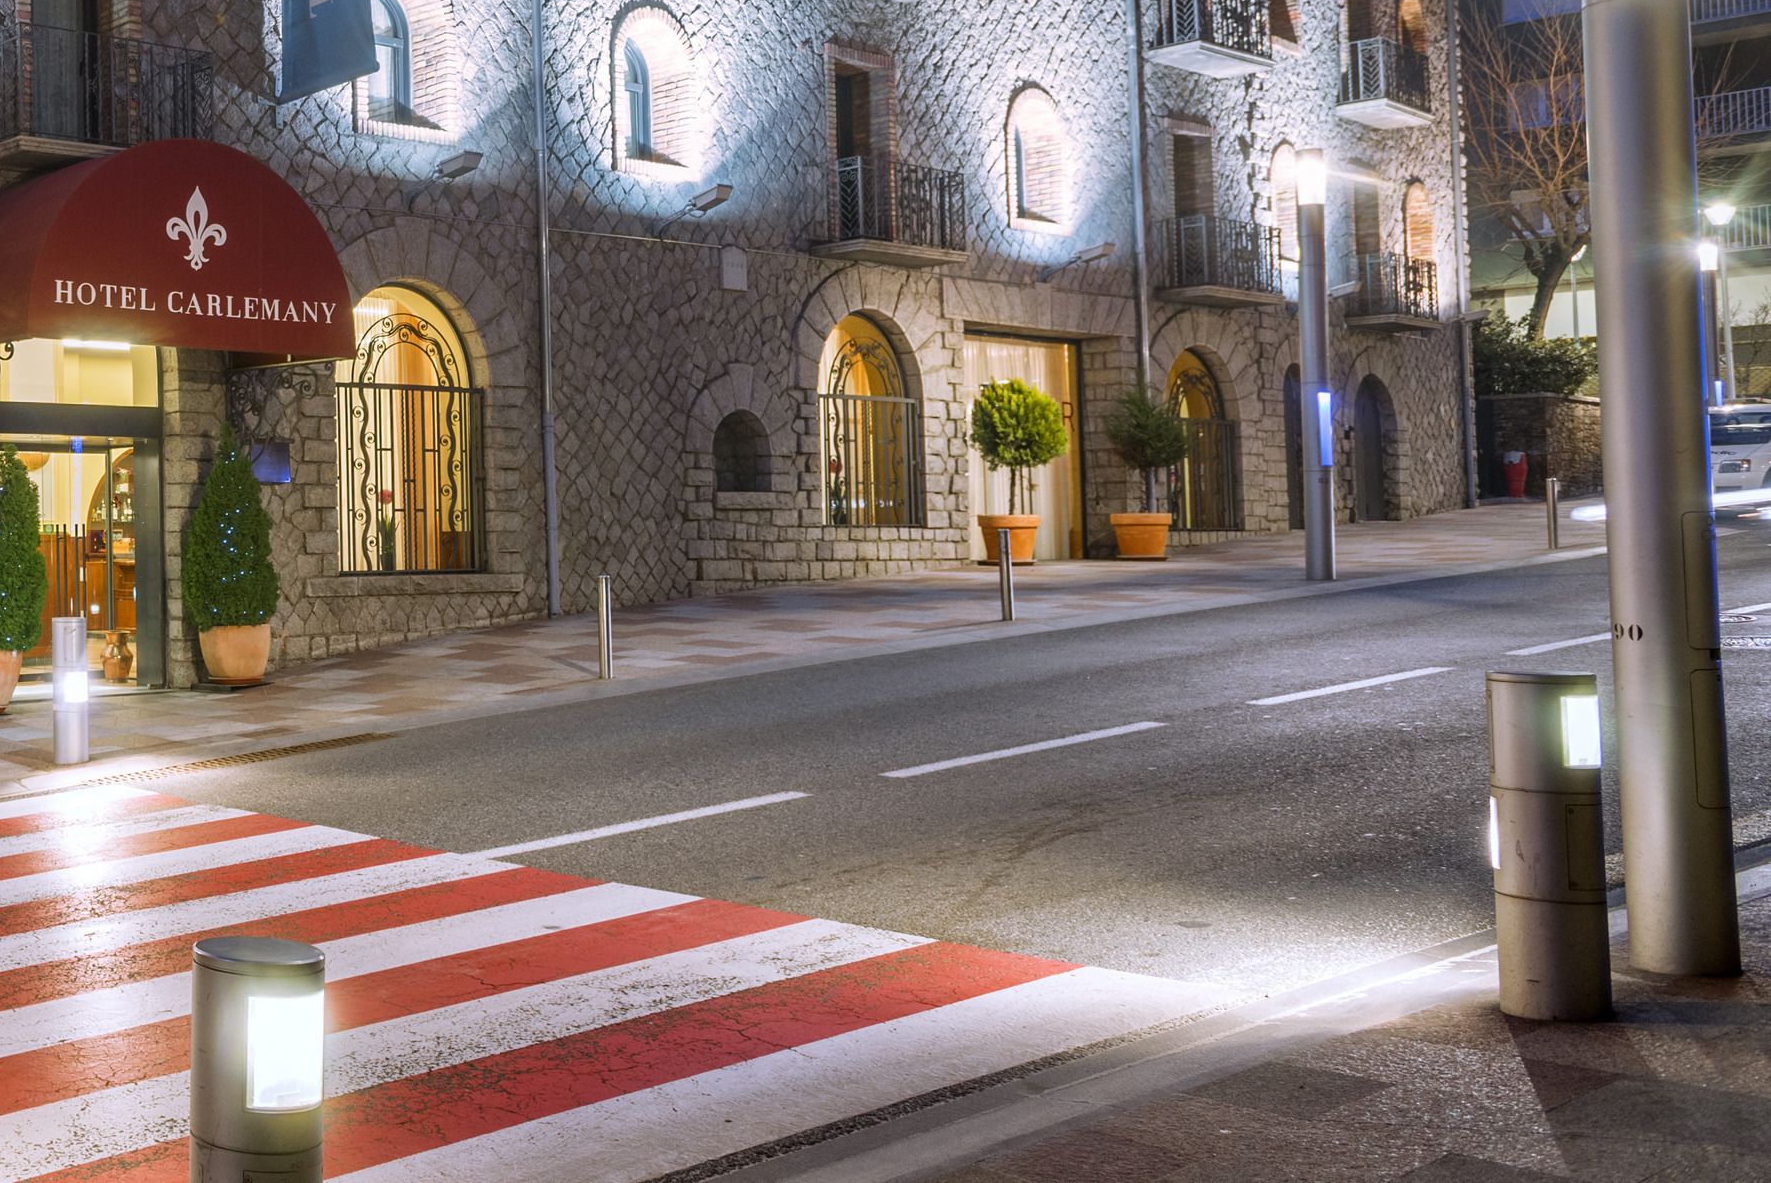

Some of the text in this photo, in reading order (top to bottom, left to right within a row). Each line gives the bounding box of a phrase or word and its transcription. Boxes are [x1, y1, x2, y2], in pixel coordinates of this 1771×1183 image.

[54, 279, 337, 324] HOTEL CARLEMANY
[1614, 623, 1644, 641] 90
